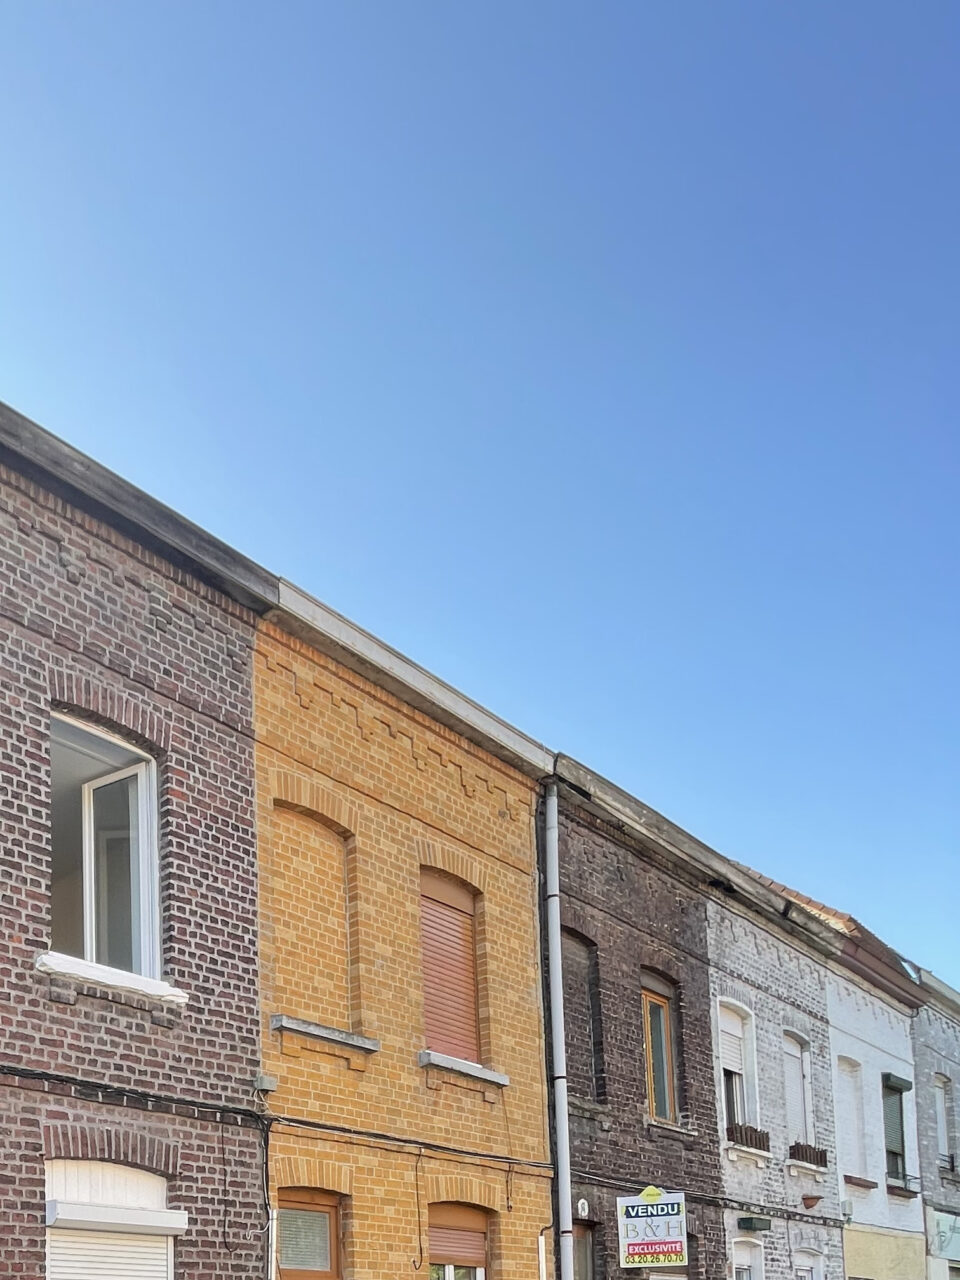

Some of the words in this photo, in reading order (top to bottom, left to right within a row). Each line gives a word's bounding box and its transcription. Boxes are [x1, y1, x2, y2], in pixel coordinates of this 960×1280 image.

[628, 1204, 678, 1217] VENDU
[623, 1223, 639, 1239] B
[644, 1217, 660, 1238] &
[665, 1220, 685, 1237] H
[629, 1243, 682, 1254] EXCLUSIVITÉ
[625, 1253, 684, 1264] 03.20.26.70.70
